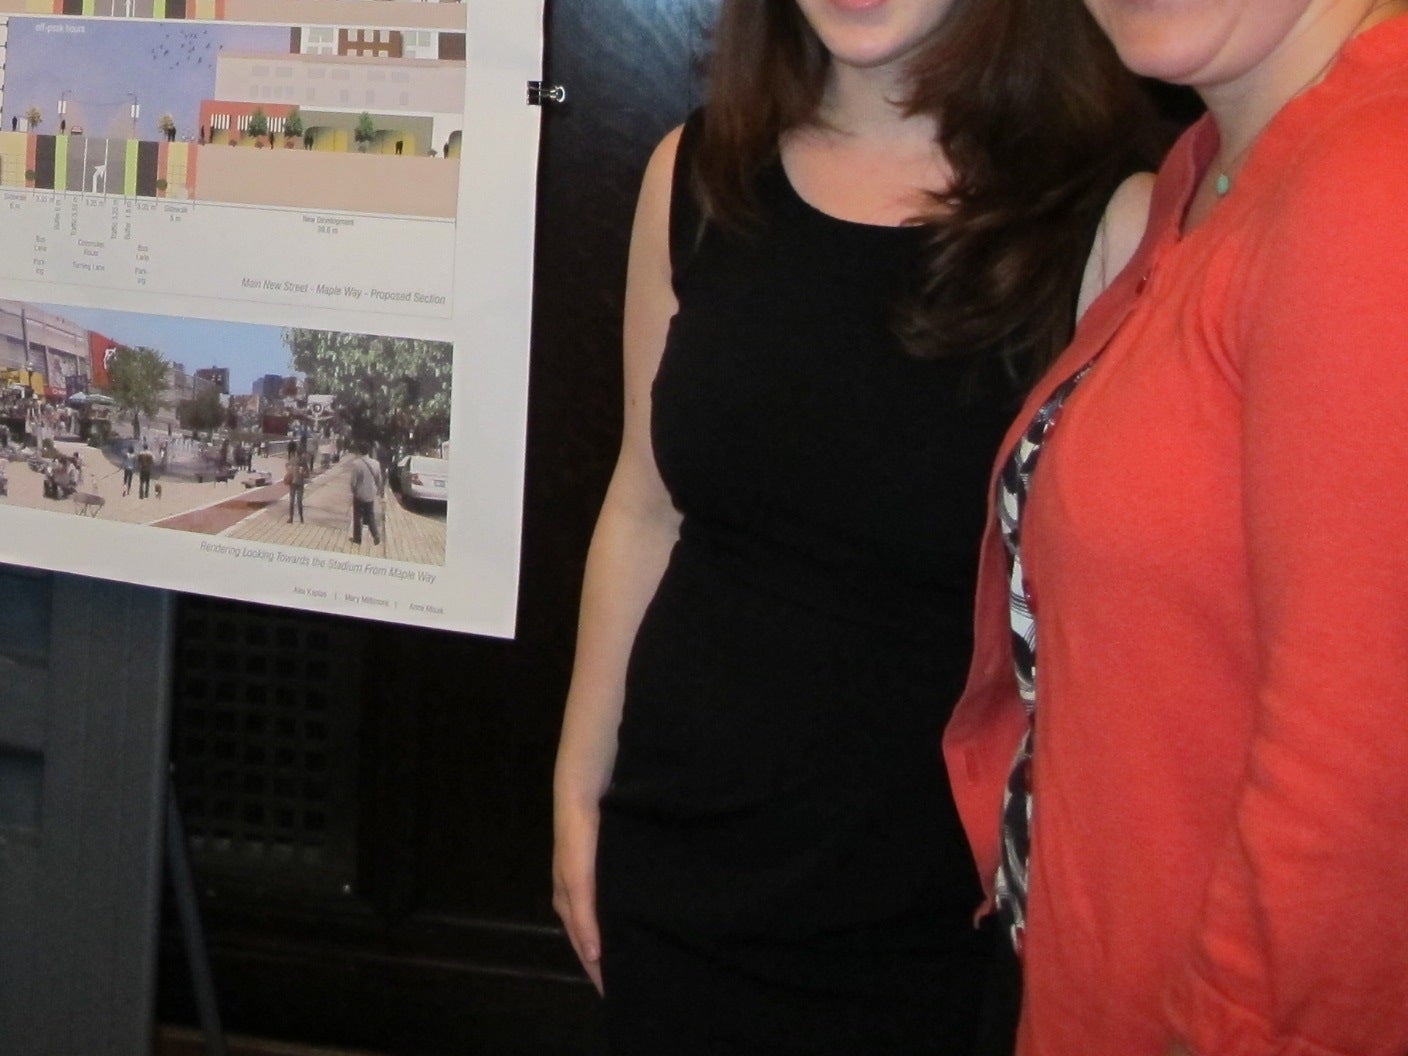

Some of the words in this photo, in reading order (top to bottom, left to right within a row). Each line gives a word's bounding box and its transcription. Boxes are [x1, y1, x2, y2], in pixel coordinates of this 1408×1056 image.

[241, 278, 261, 289] Main
[263, 280, 281, 291] New
[283, 281, 308, 293] Street
[316, 284, 342, 297] Maple
[344, 286, 362, 299] Way
[370, 289, 411, 303] Proposed
[414, 293, 446, 304] Section
[200, 541, 241, 558] Rendering
[243, 547, 274, 562] Looking
[276, 551, 310, 567] Towards
[311, 557, 326, 568] the
[328, 558, 363, 573] Stadium
[364, 563, 387, 576] From
[389, 566, 416, 581] Maple
[418, 571, 437, 584] Way
